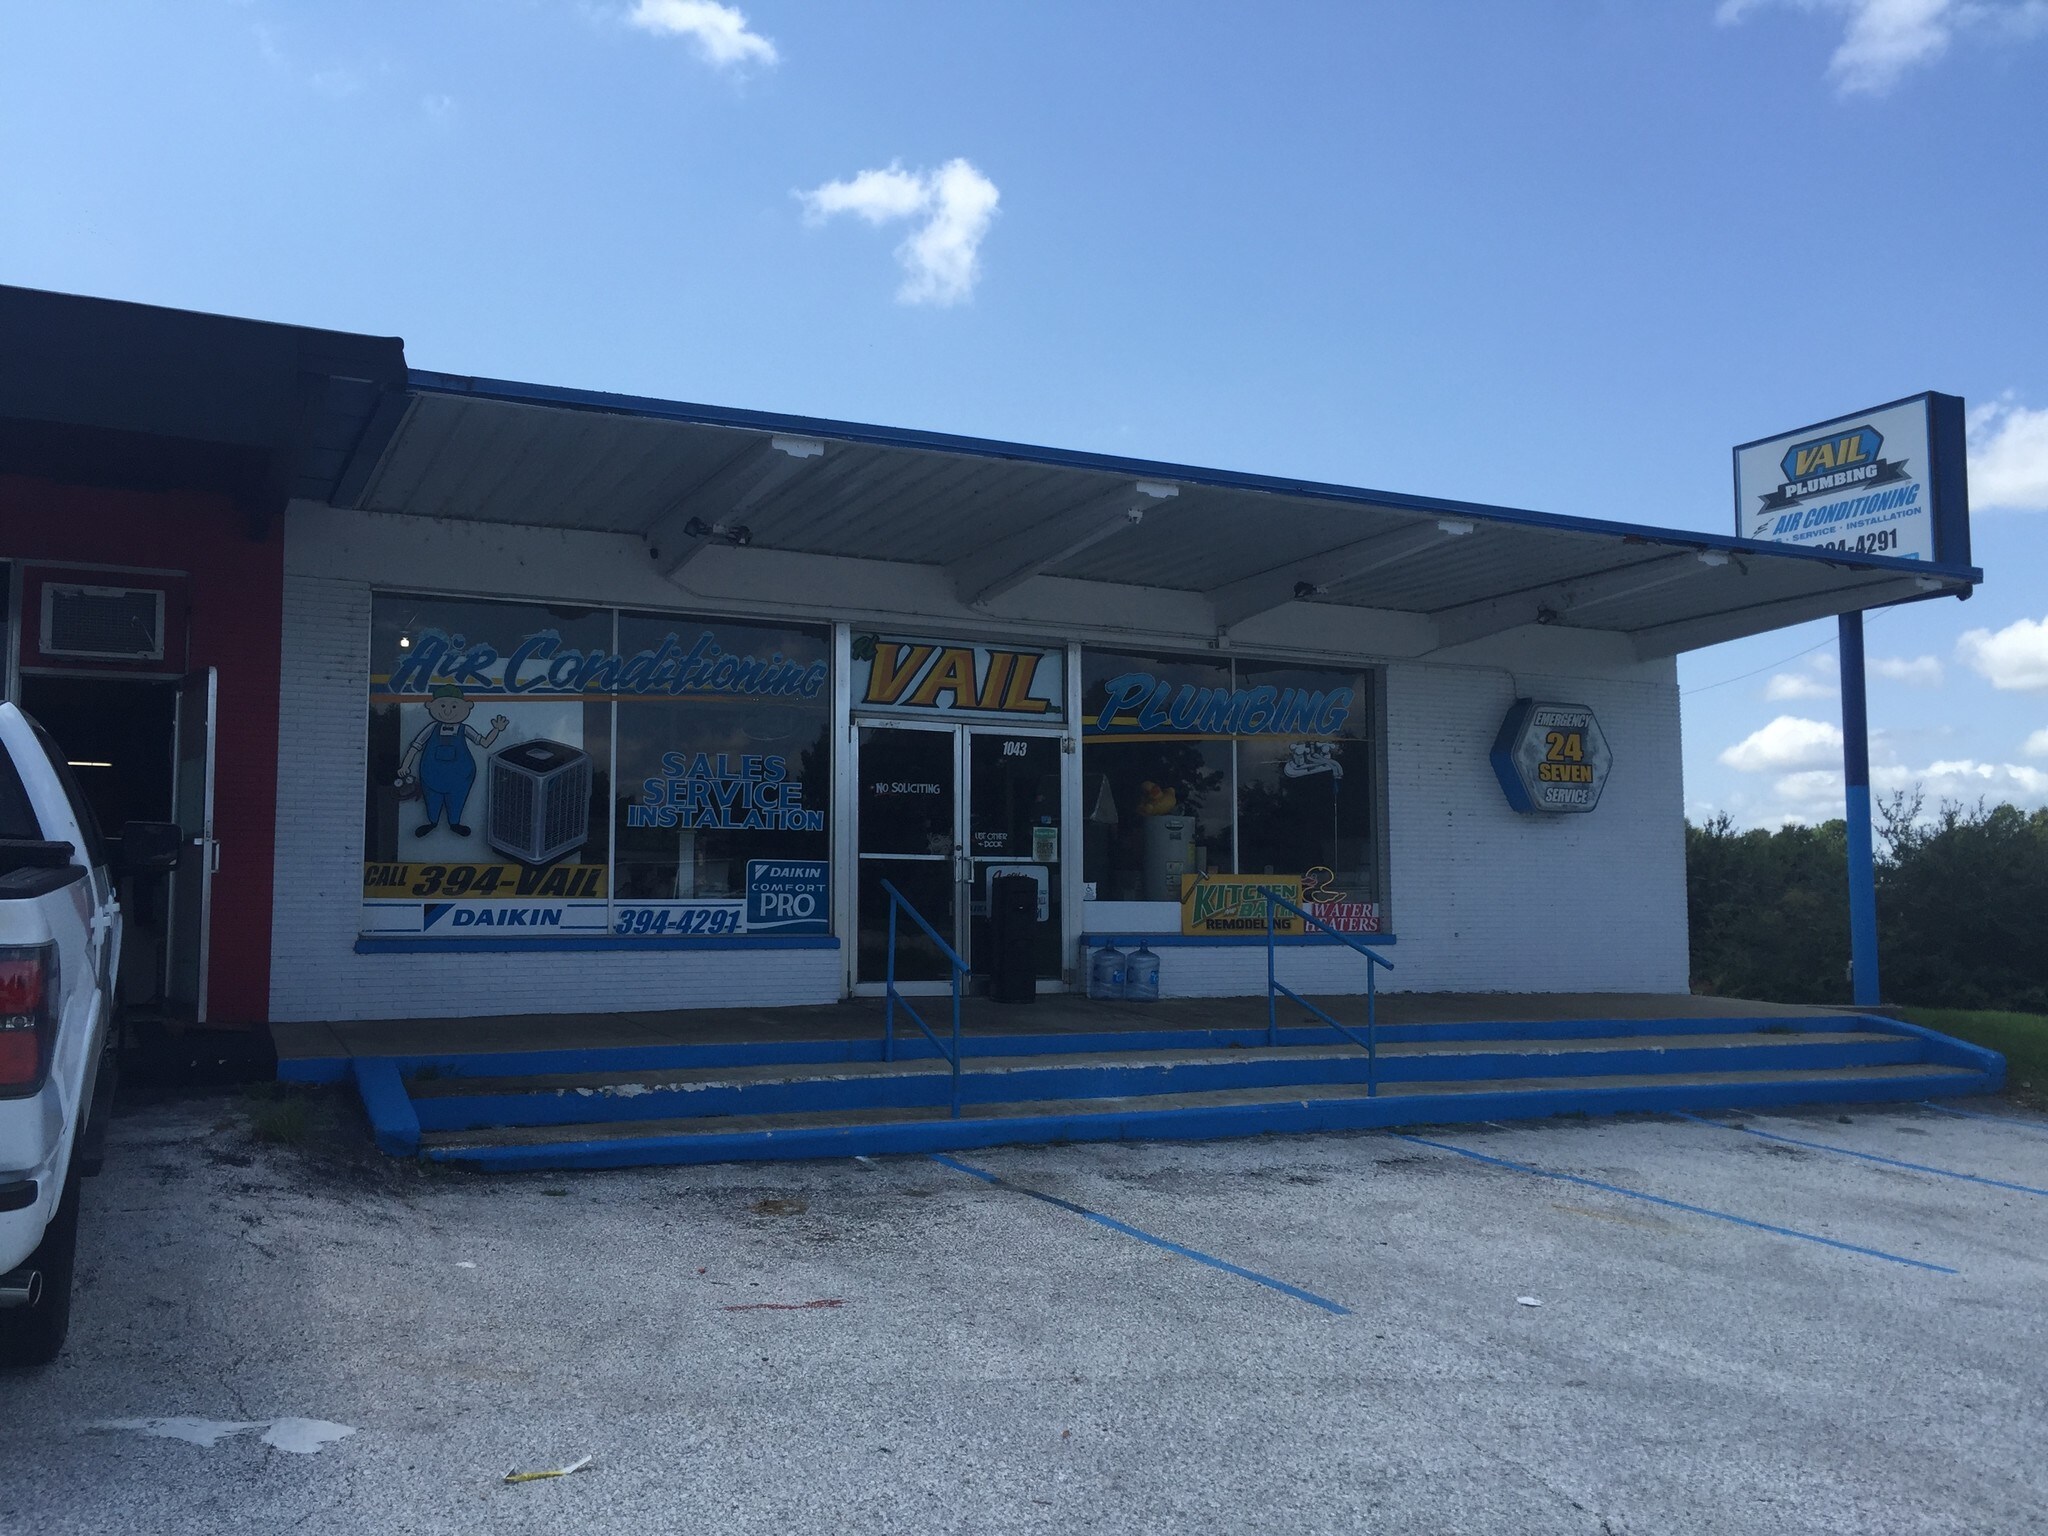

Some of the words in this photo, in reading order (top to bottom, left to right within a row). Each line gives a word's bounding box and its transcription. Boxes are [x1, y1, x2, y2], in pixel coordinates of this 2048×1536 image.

[1795, 435, 1867, 476] VAIL
[1785, 465, 1878, 498] PLUMBING
[1773, 511, 1803, 536] AIR
[1802, 484, 1920, 529] CONDITIONING
[1792, 526, 1837, 542] SERVICE
[1846, 507, 1922, 530] INSTALLATION
[861, 641, 1050, 714] VAIL
[1097, 672, 1354, 736] PLUMBING
[1534, 712, 1593, 727] EMERGENCY
[1003, 741, 1028, 757] 1043
[1546, 731, 1584, 762] 24
[661, 751, 786, 782] SALES
[1538, 762, 1593, 783] SEVEN
[643, 778, 803, 809] SERVICE
[876, 783, 888, 794] NO
[892, 782, 940, 795] SOLICITING
[1545, 788, 1589, 804] SERVICE
[627, 805, 825, 831] INSTALATION
[364, 866, 409, 887] CALL
[412, 865, 602, 897] 394-VAIL
[770, 867, 821, 878] DAIKIN
[752, 883, 826, 892] COMFORT
[760, 893, 816, 917] PRO
[1238, 899, 1296, 918] BAH
[1314, 904, 1372, 917] WATER
[452, 909, 562, 926] DAIKIN
[615, 909, 741, 934] 394-4291
[1206, 919, 1290, 929] REMODELNG
